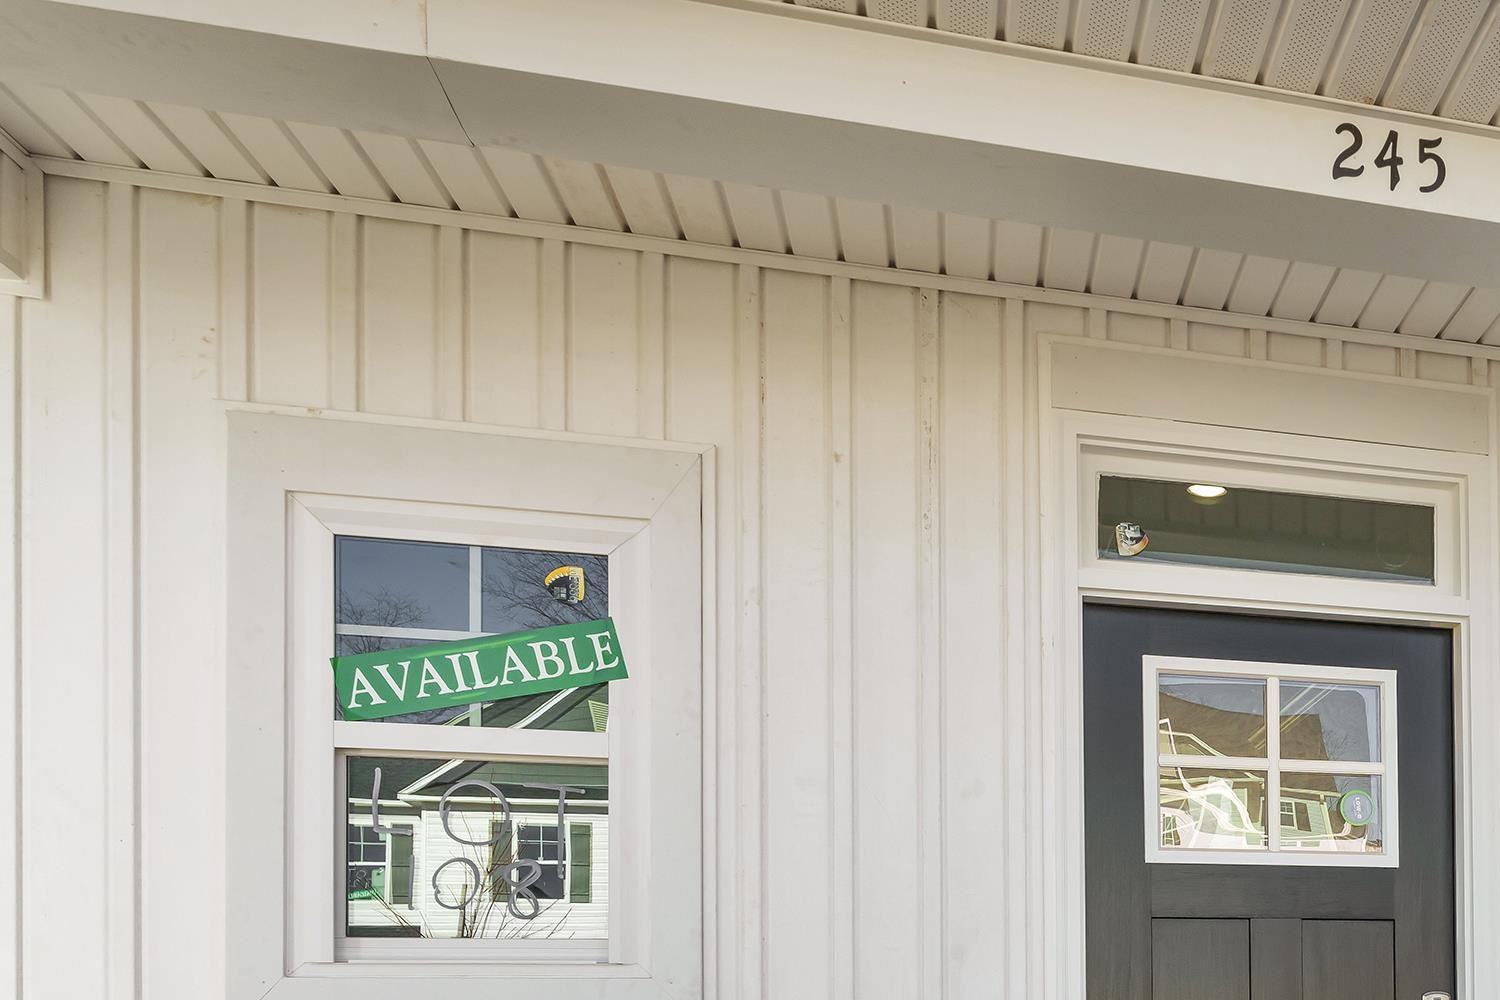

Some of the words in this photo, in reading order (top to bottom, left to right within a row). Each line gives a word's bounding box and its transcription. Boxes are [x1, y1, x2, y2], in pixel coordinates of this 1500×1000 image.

[1333, 123, 1446, 193] 245
[347, 630, 619, 709] AVAILABLE
[372, 767, 586, 879] LOT
[407, 854, 542, 920] 108
